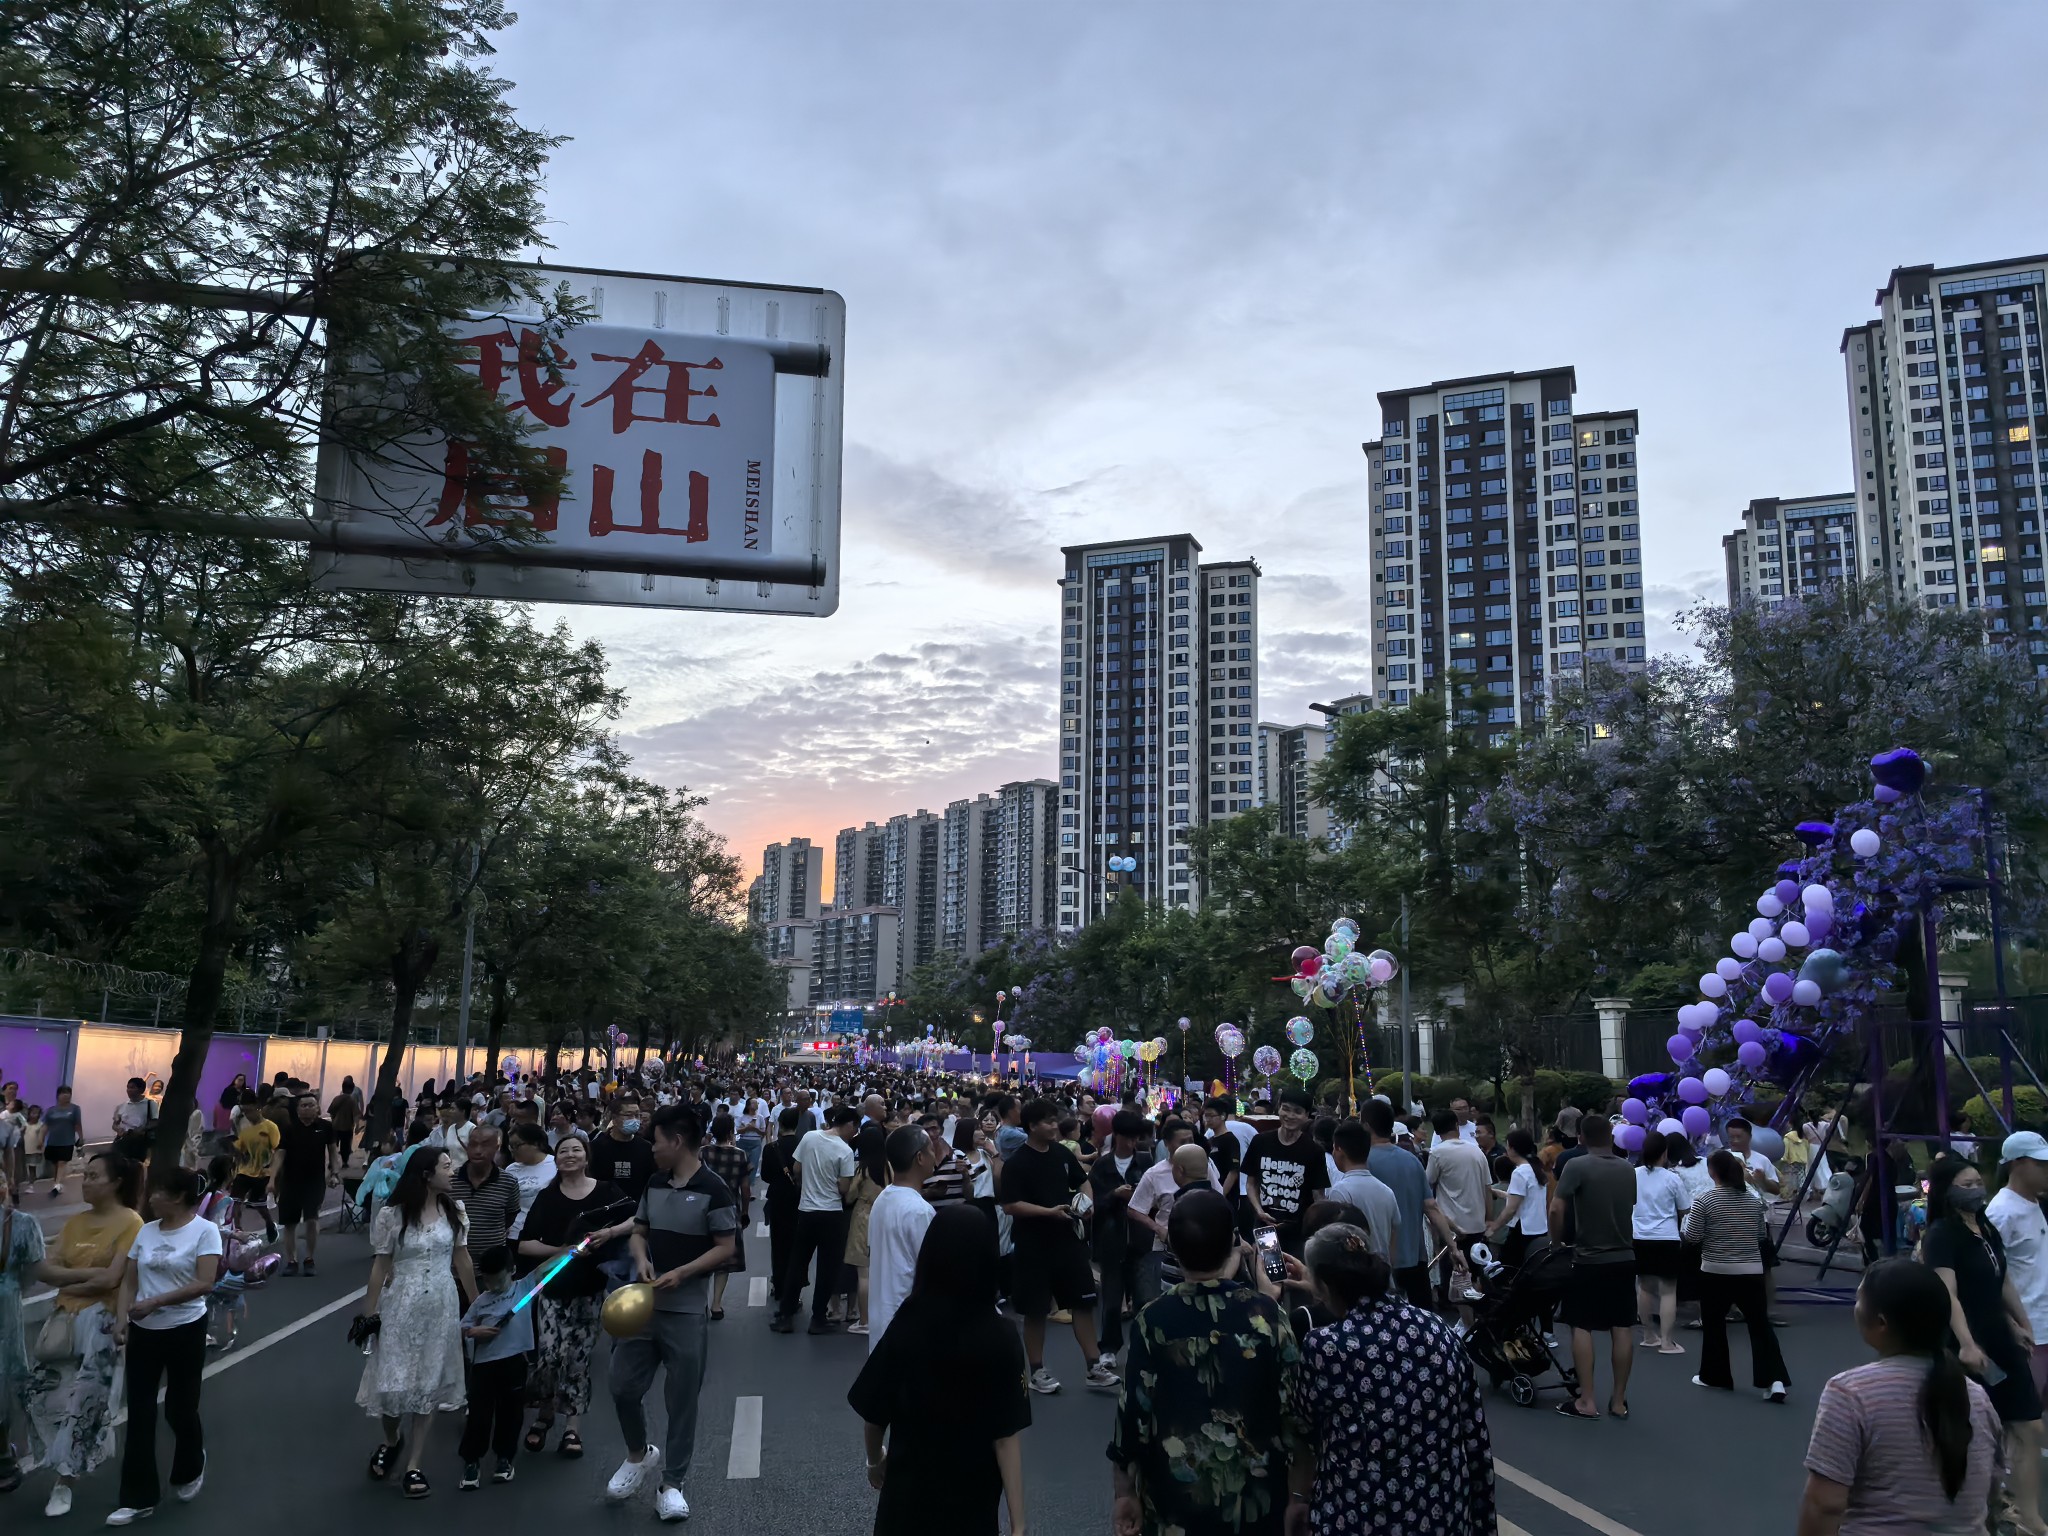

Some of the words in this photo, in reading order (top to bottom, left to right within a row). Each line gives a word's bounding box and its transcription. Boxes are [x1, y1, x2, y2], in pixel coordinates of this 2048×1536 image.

[446, 328, 724, 435] 我在
[744, 459, 761, 551] MEISHAN
[1262, 1171, 1294, 1187] Smile
[1267, 1184, 1301, 1200] Good
